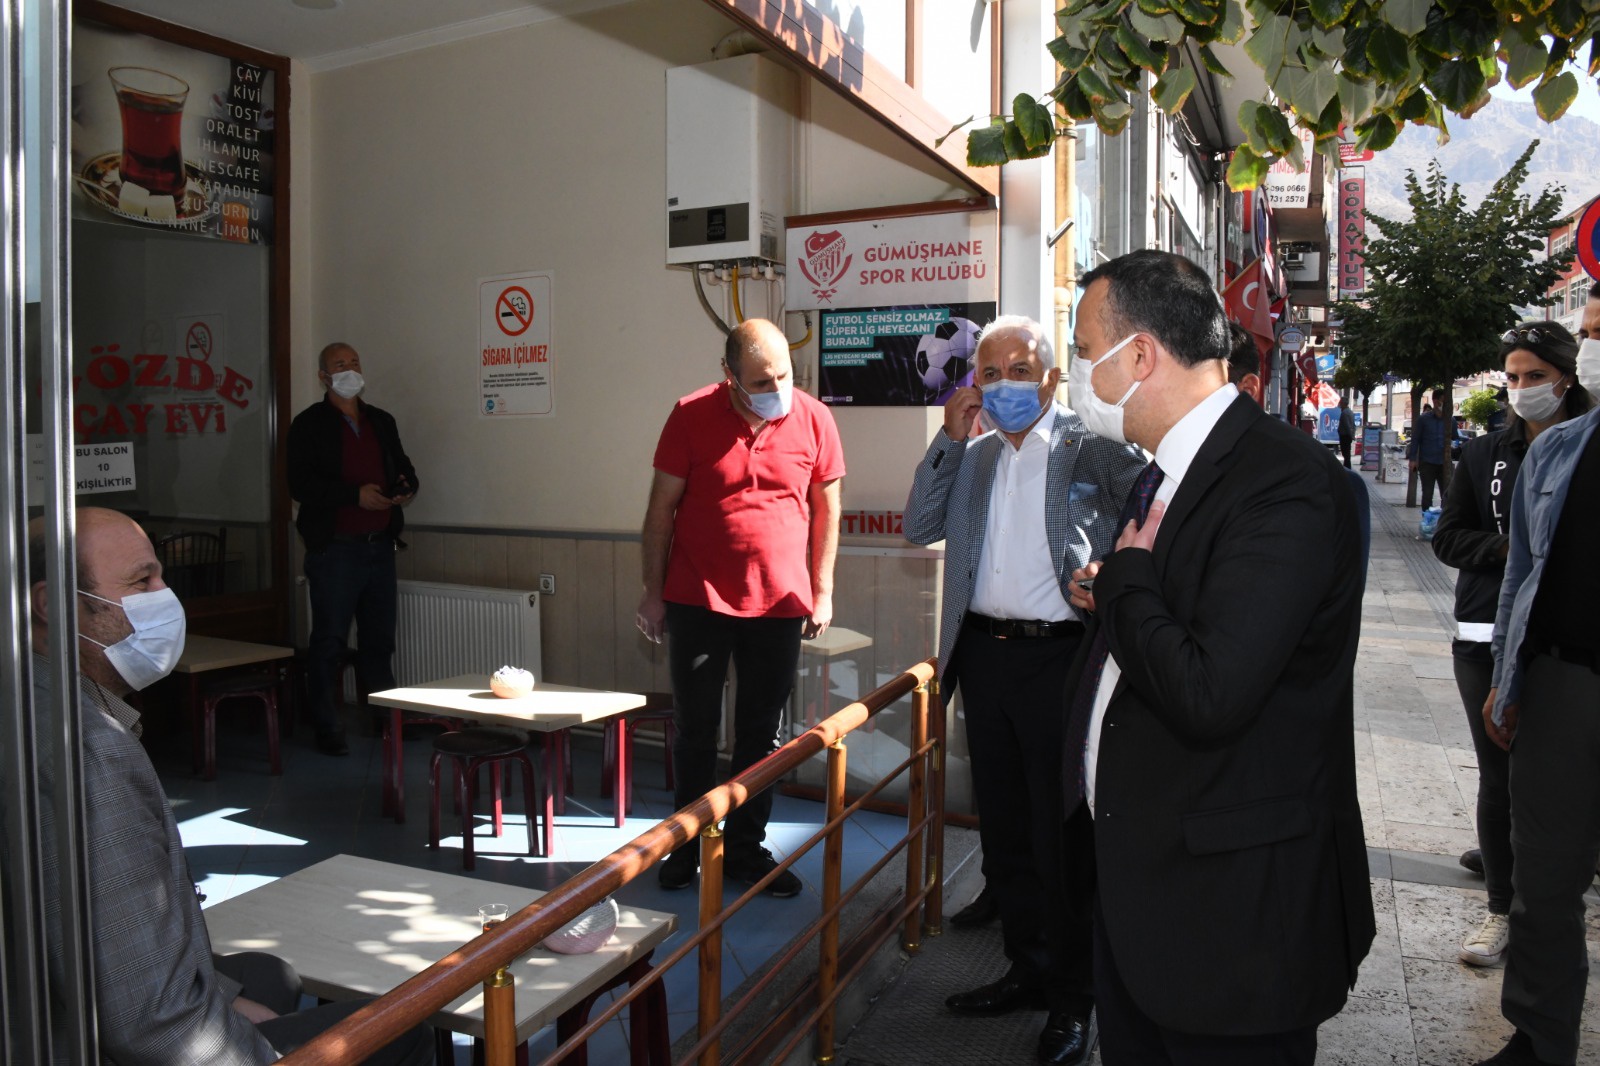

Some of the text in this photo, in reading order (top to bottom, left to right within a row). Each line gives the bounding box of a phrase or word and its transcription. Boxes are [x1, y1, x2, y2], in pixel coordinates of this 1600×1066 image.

[236, 66, 260, 83] ÇAY
[233, 84, 260, 103] KİVİ
[226, 103, 260, 122] TOST
[207, 119, 260, 142] ORALET
[199, 159, 259, 182] NESCAFE
[195, 177, 259, 200] KARADUT
[1270, 195, 1304, 203] 731 2578
[864, 240, 983, 263] GÜMÜŞHANE
[860, 260, 986, 285] SPOR KULÜBÜ
[826, 312, 945, 325] FUTBOL SENSİZ OLMAZ.
[826, 324, 930, 336] SÜPER LİG HEYECANI
[826, 337, 870, 346] BURADA!
[482, 342, 548, 368] SİGARA İÇİLMEZ
[74, 403, 155, 444] ÇAY
[76, 446, 128, 457] BU SALON
[98, 463, 110, 471] 10
[76, 476, 132, 490] KİŞİLİKTİR
[839, 510, 904, 534] TİNİZ
